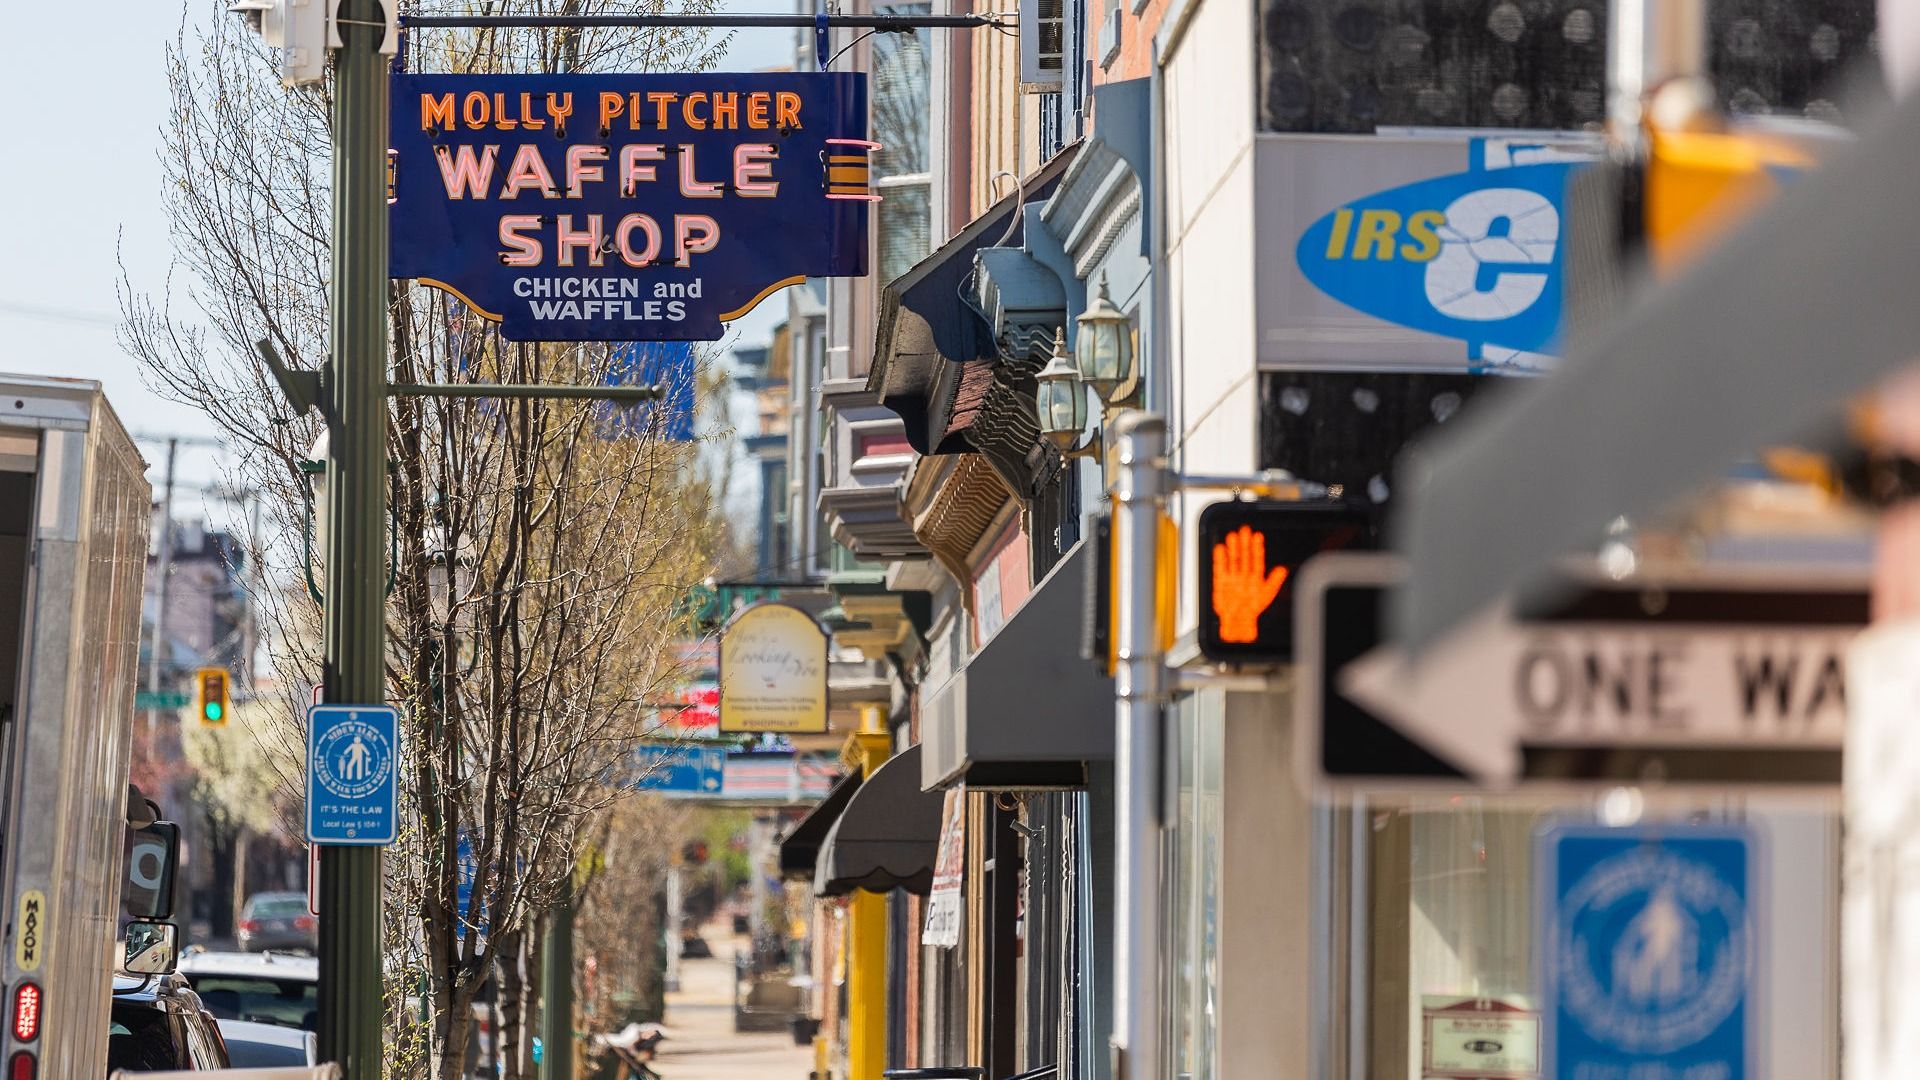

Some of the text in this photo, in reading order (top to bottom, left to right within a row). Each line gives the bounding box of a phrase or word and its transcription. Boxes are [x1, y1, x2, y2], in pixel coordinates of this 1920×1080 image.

[421, 91, 802, 131] MOLLY PITCHER
[433, 143, 779, 200] WAFFLE
[499, 213, 721, 268] SHOP
[1325, 208, 1447, 262] IRS
[513, 277, 702, 299] CHICKEN and
[529, 300, 687, 321] WAFFLES
[1515, 641, 1845, 731] ONE WA
[320, 805, 383, 815] IT'S THE LAW
[322, 820, 340, 828] Local
[341, 821, 356, 829] Law
[24, 899, 39, 961] MAXON
